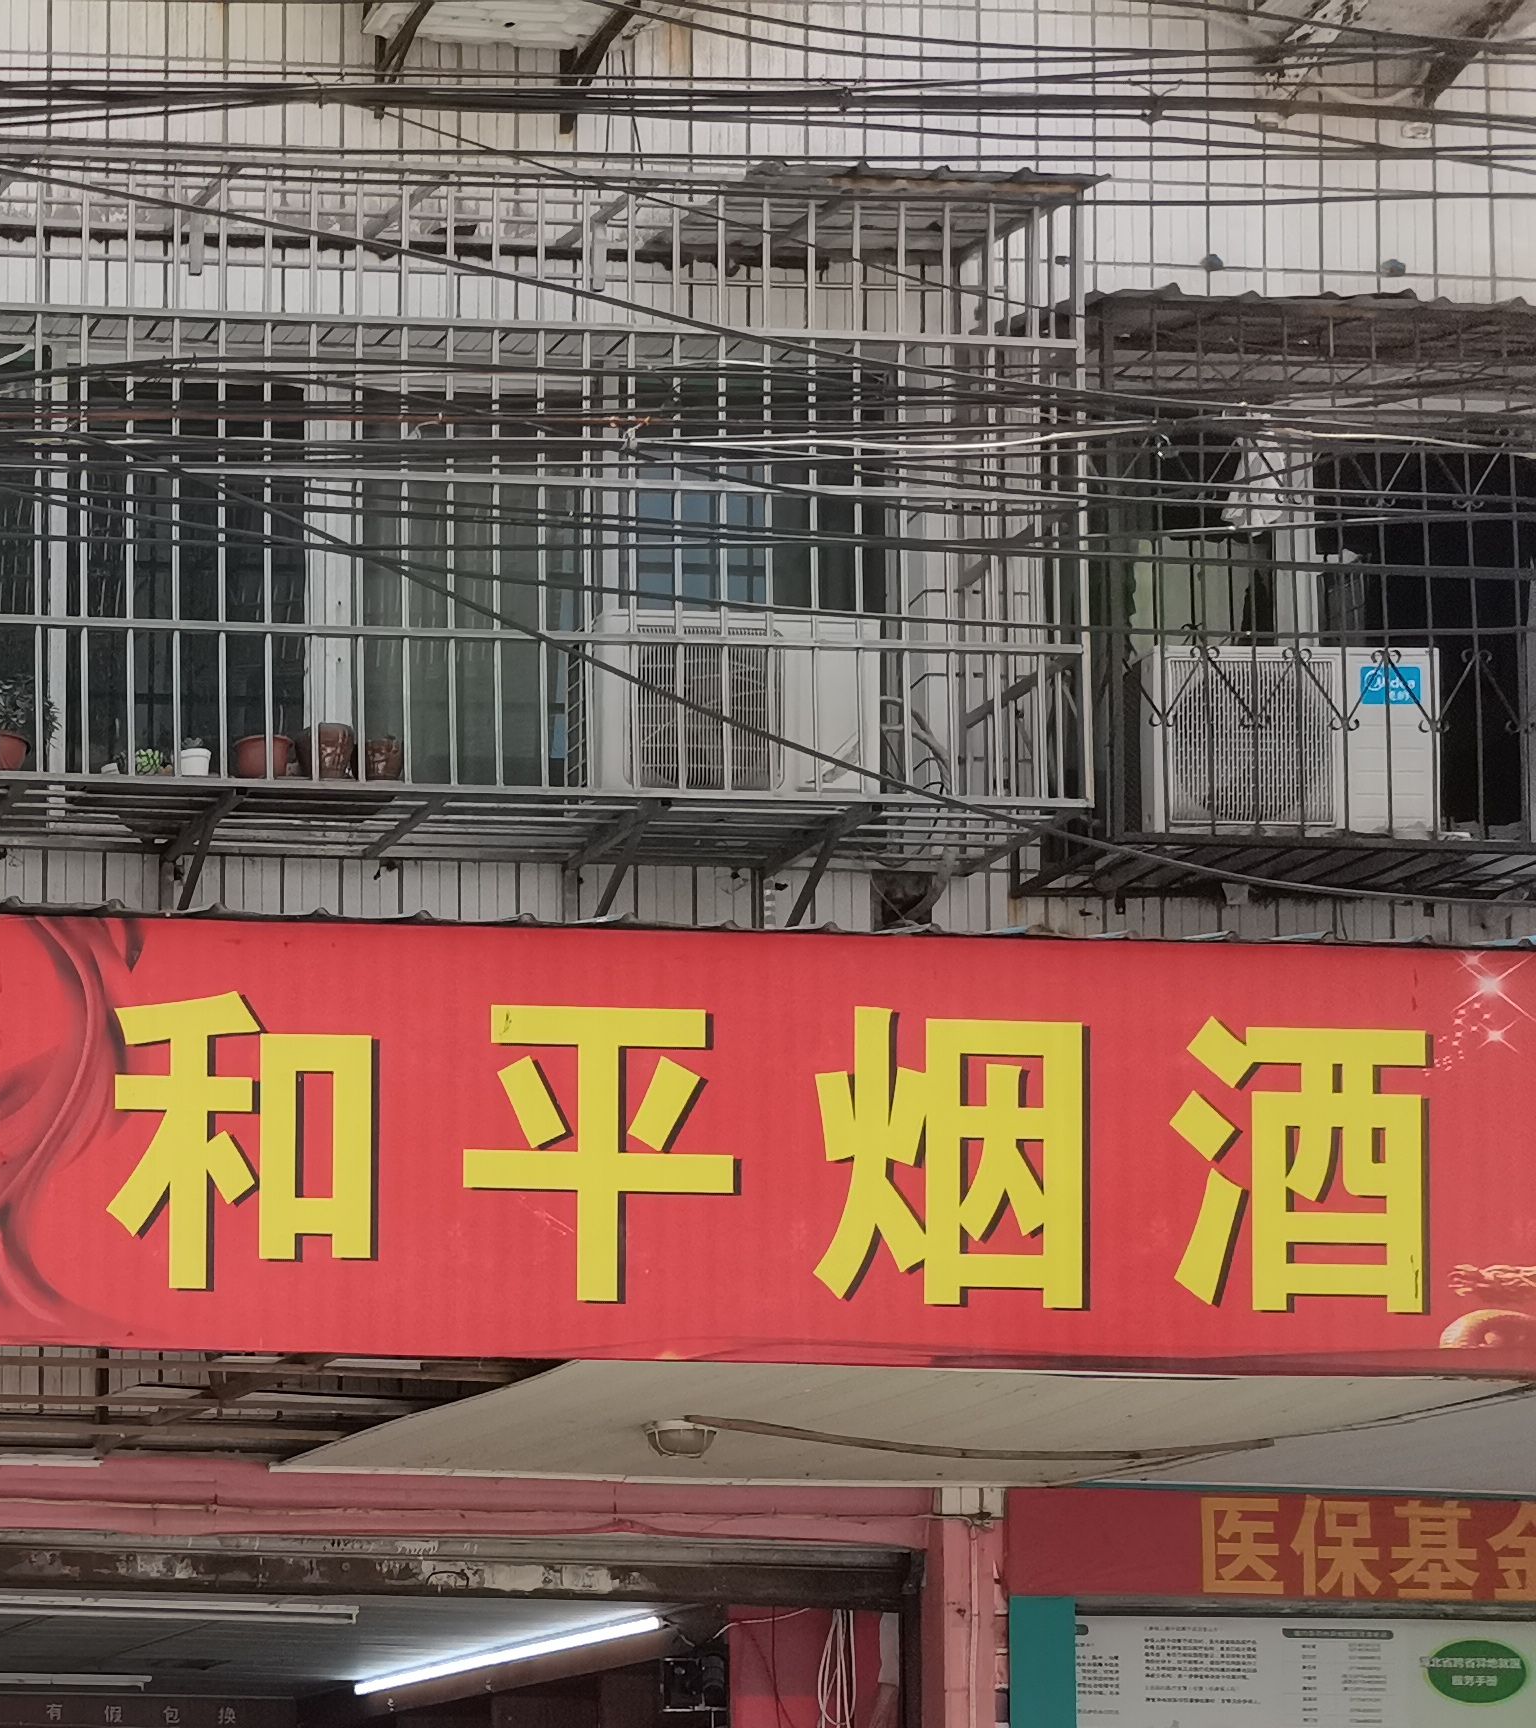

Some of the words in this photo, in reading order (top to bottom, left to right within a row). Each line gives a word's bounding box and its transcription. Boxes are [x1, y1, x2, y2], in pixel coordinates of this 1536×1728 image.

[106, 990, 1434, 1314] 和平烟酒
[1199, 1495, 1536, 1600] 医保基金
[46, 1703, 237, 1725] 有假包换
